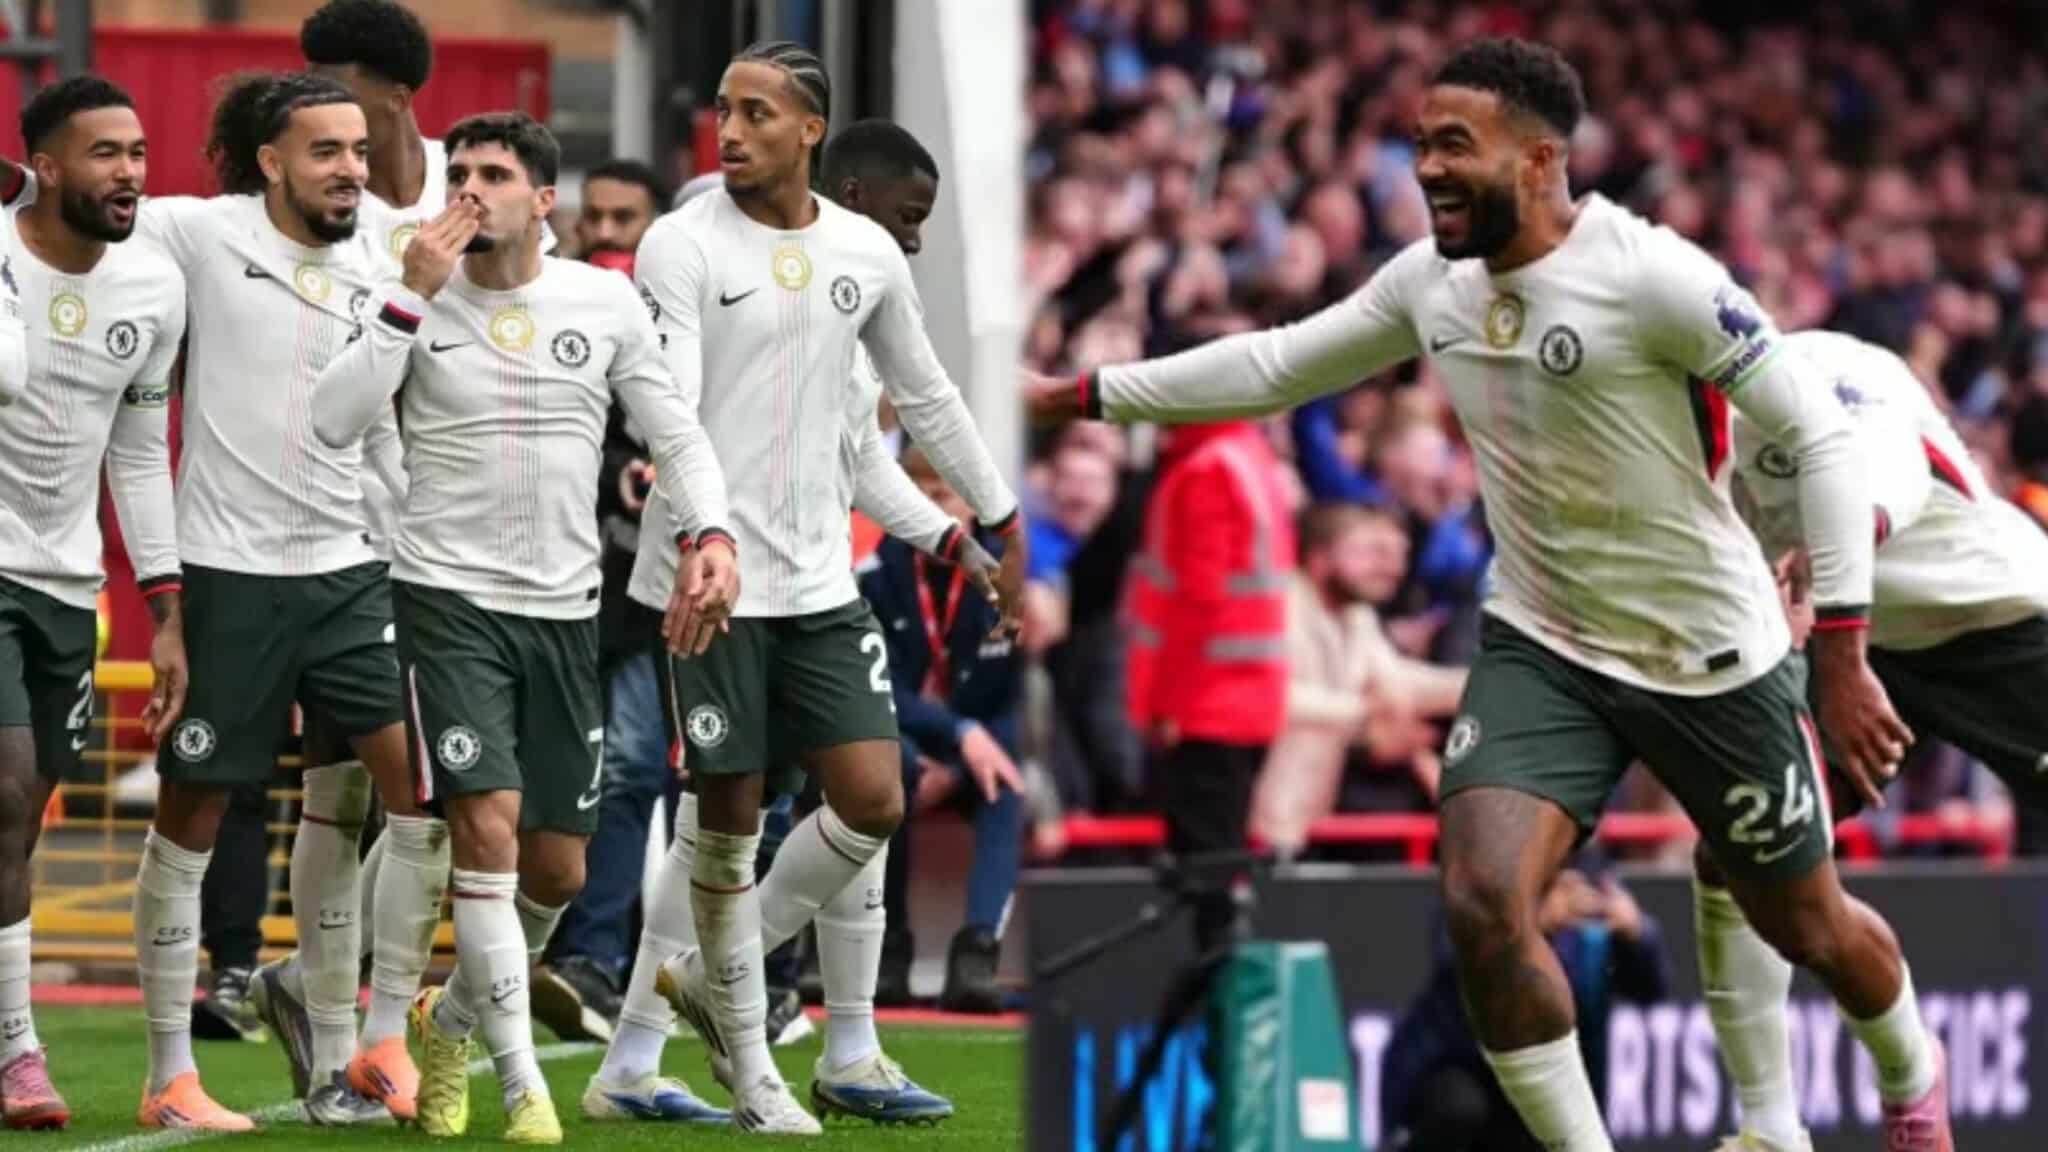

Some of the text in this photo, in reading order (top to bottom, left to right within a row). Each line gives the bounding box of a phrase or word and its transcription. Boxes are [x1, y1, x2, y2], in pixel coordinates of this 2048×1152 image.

[1725, 762, 1814, 842] 24
[1606, 1002, 1719, 1139] RTS
[1853, 988, 2031, 1122] OICE
